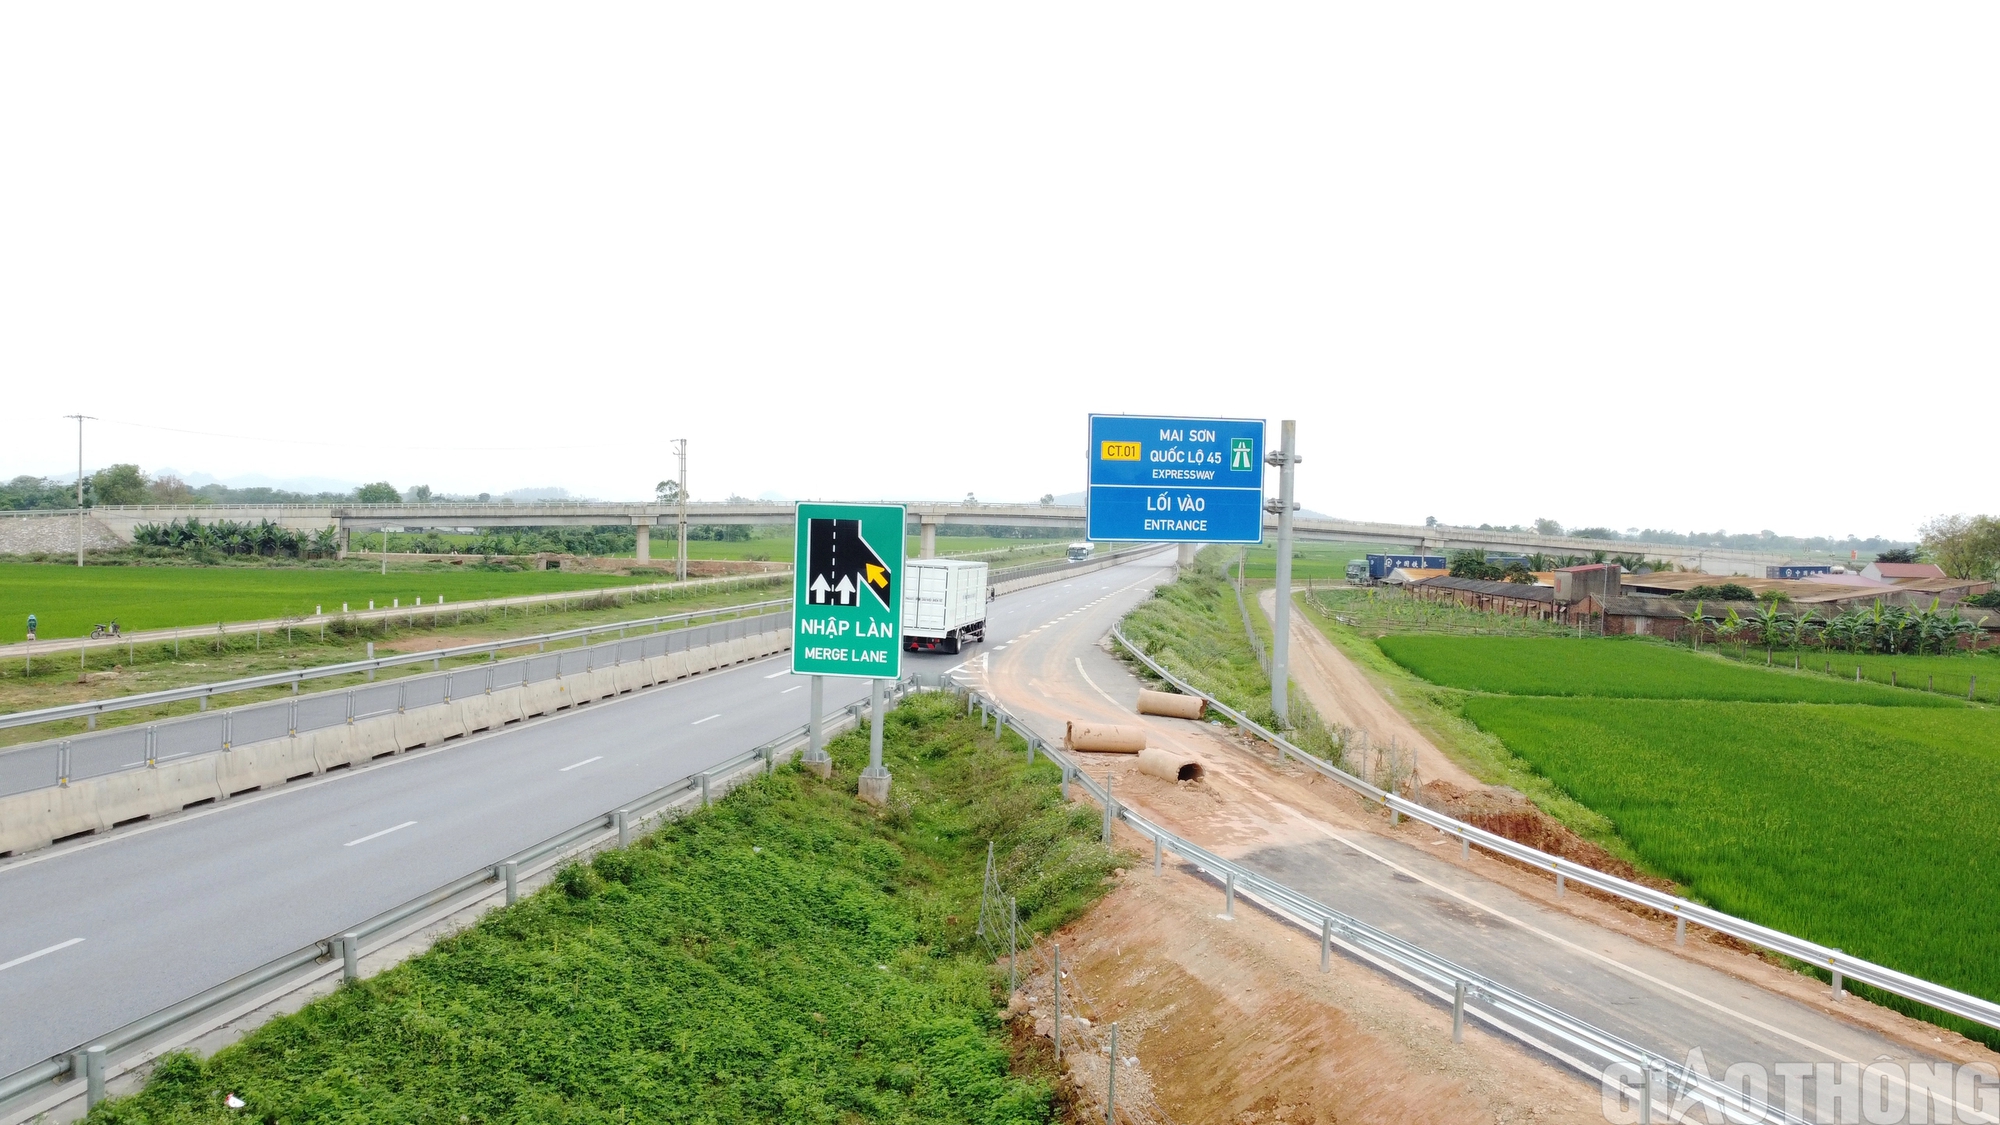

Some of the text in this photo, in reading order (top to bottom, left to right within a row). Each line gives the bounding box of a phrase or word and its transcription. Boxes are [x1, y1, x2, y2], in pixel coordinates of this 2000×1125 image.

[1159, 429, 1216, 443] MAI SƠN
[1107, 445, 1136, 458] CT.01
[1150, 446, 1222, 466] QUỐC LỘ 45
[1152, 469, 1216, 481] EXPRESSWAY
[1146, 491, 1206, 512] LỐI VÀO
[1144, 519, 1208, 532] ENTRANCE
[801, 616, 893, 639] NHẬP LÀN
[805, 647, 888, 663] MERGE LANE
